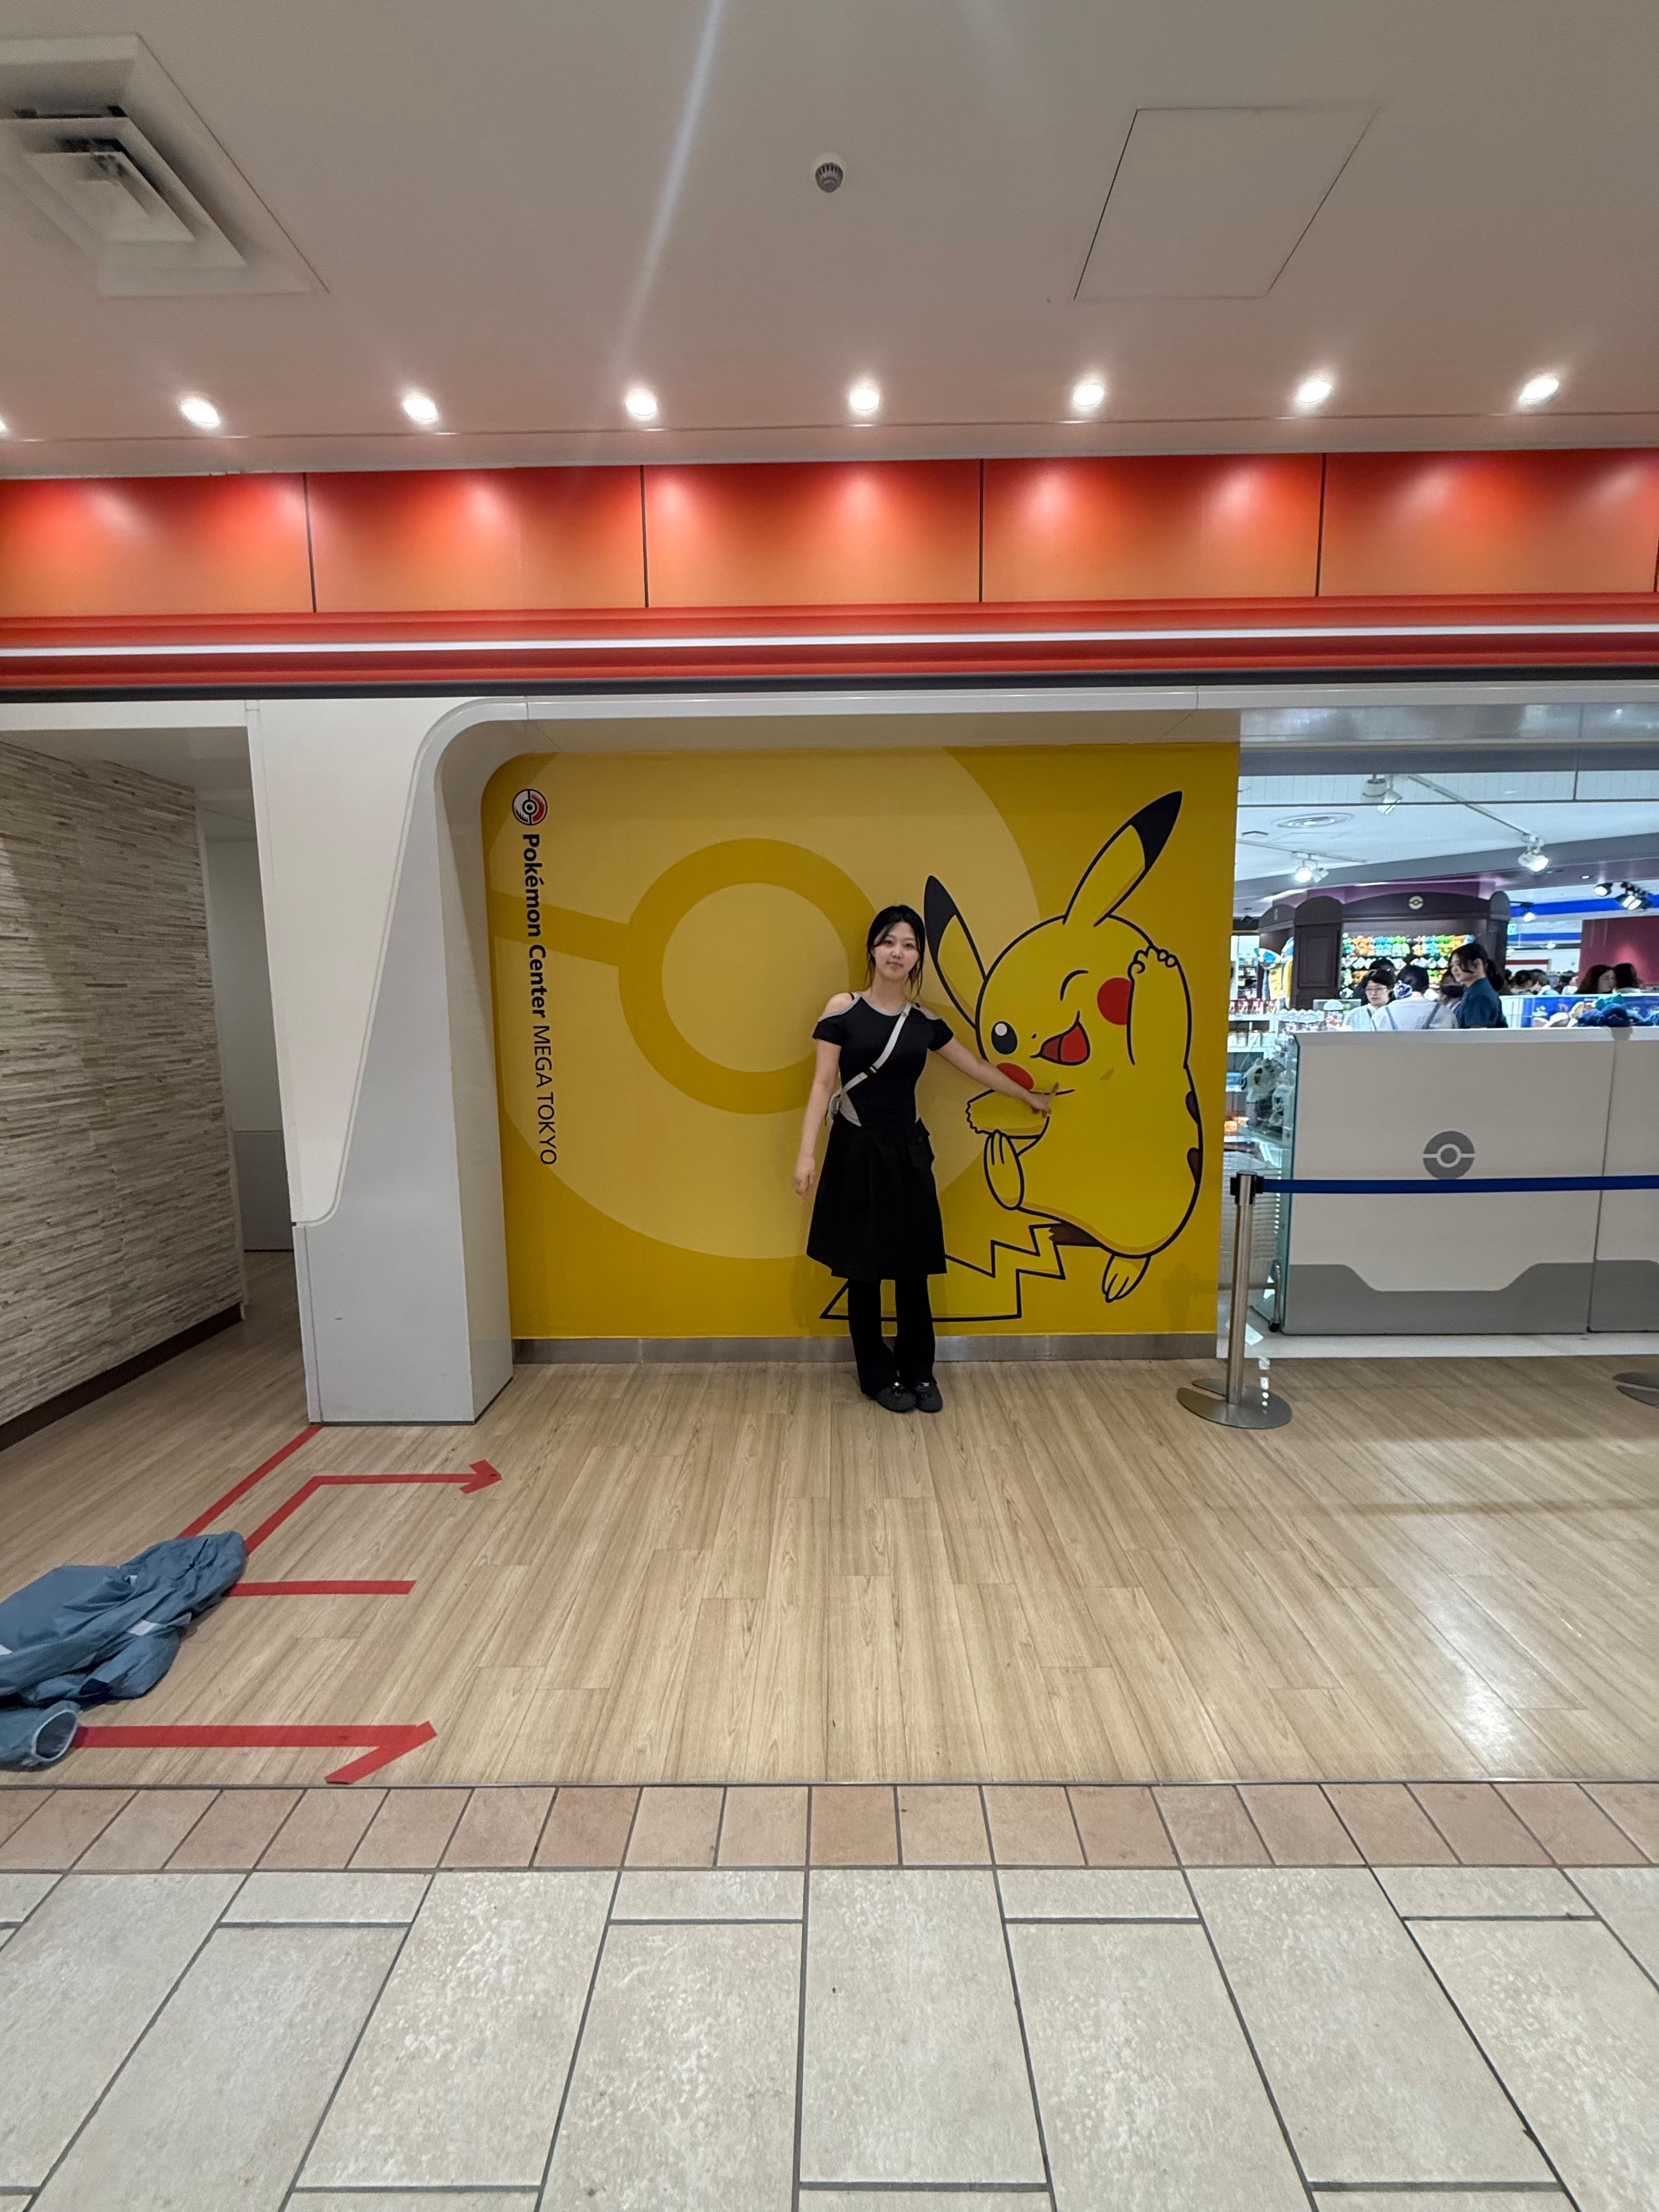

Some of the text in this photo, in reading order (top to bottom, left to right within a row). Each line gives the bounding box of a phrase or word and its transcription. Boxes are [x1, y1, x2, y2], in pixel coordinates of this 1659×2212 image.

[522, 833, 557, 1165] Pokémon Center MEGA TOKYO
